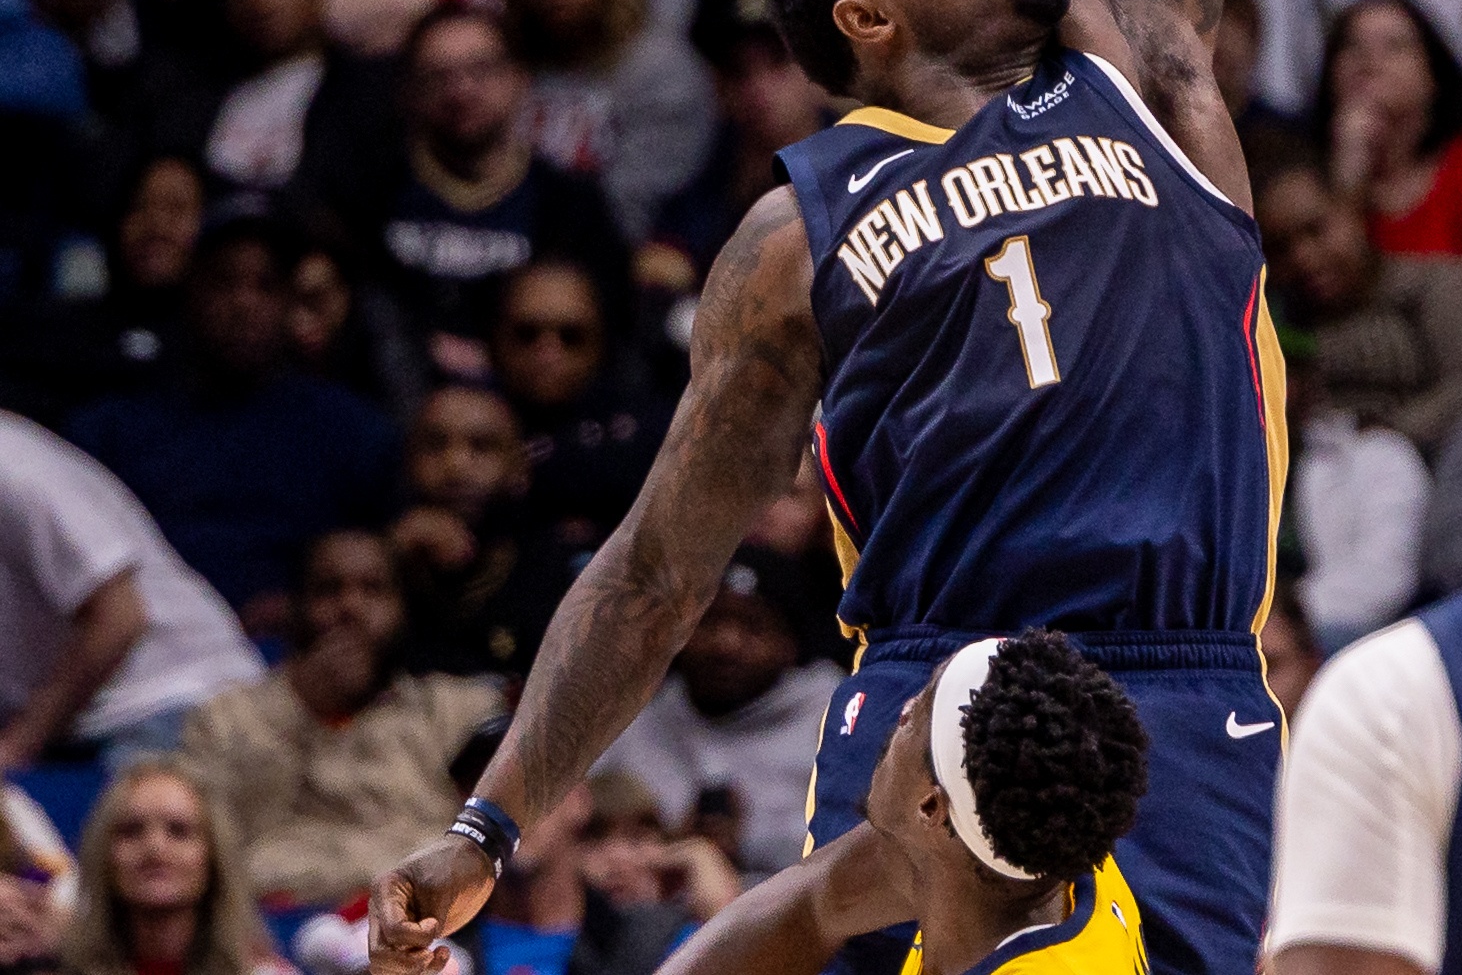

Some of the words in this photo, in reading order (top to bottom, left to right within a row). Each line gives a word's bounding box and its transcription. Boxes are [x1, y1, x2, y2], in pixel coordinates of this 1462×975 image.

[837, 179, 944, 307] NEW
[941, 135, 1159, 229] ORLEANS
[984, 234, 1062, 390] 1
